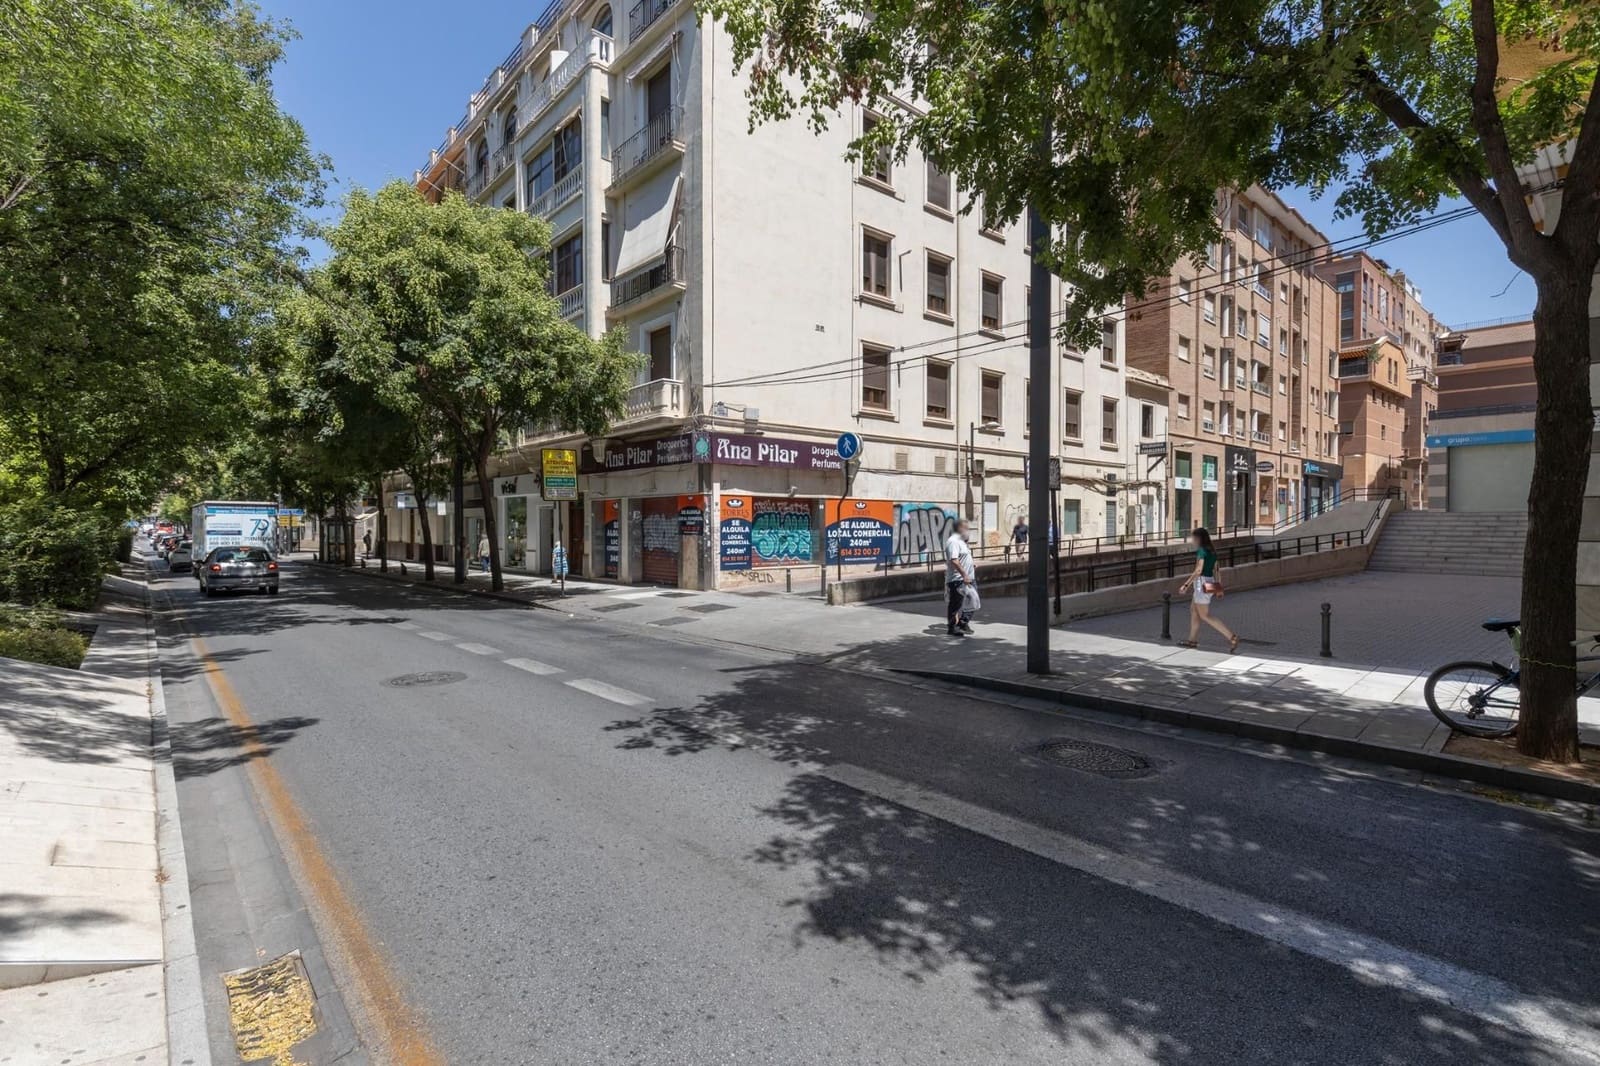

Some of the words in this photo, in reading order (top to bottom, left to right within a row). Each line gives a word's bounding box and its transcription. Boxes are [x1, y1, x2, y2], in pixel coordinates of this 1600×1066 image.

[717, 438, 752, 460] Ana
[757, 443, 799, 463] Pilar
[626, 447, 653, 465] Pilar
[840, 521, 850, 529] SE
[851, 521, 881, 529] ALQUILA
[853, 529, 892, 537] COMERCIAL
[853, 548, 862, 556] 32
[863, 548, 872, 556] 00
